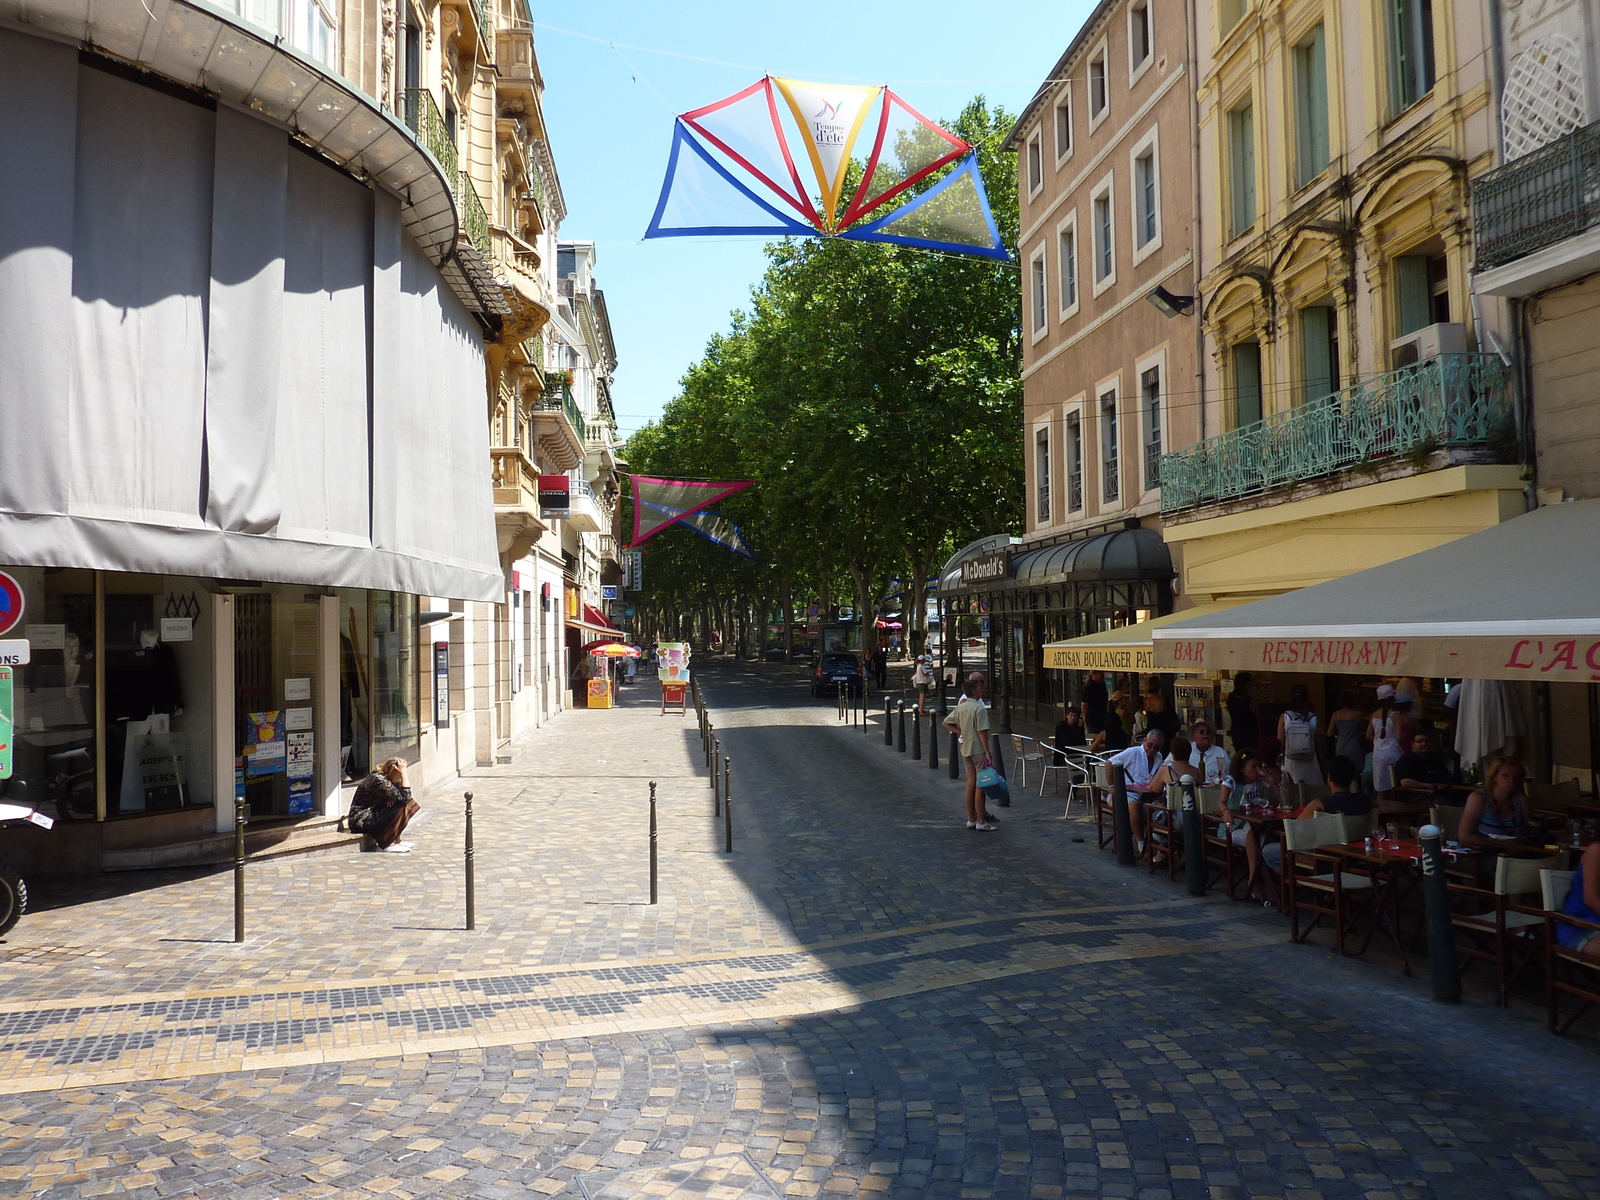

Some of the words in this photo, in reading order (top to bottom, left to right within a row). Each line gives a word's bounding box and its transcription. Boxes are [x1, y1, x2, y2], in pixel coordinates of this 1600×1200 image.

[816, 130, 844, 143] d'été
[963, 556, 1004, 581] McDonald's
[1053, 651, 1081, 667] ARTISAN
[1084, 651, 1131, 668] BOULANGER
[1173, 642, 1205, 662] BAR
[1262, 641, 1408, 666] RESTAURANT
